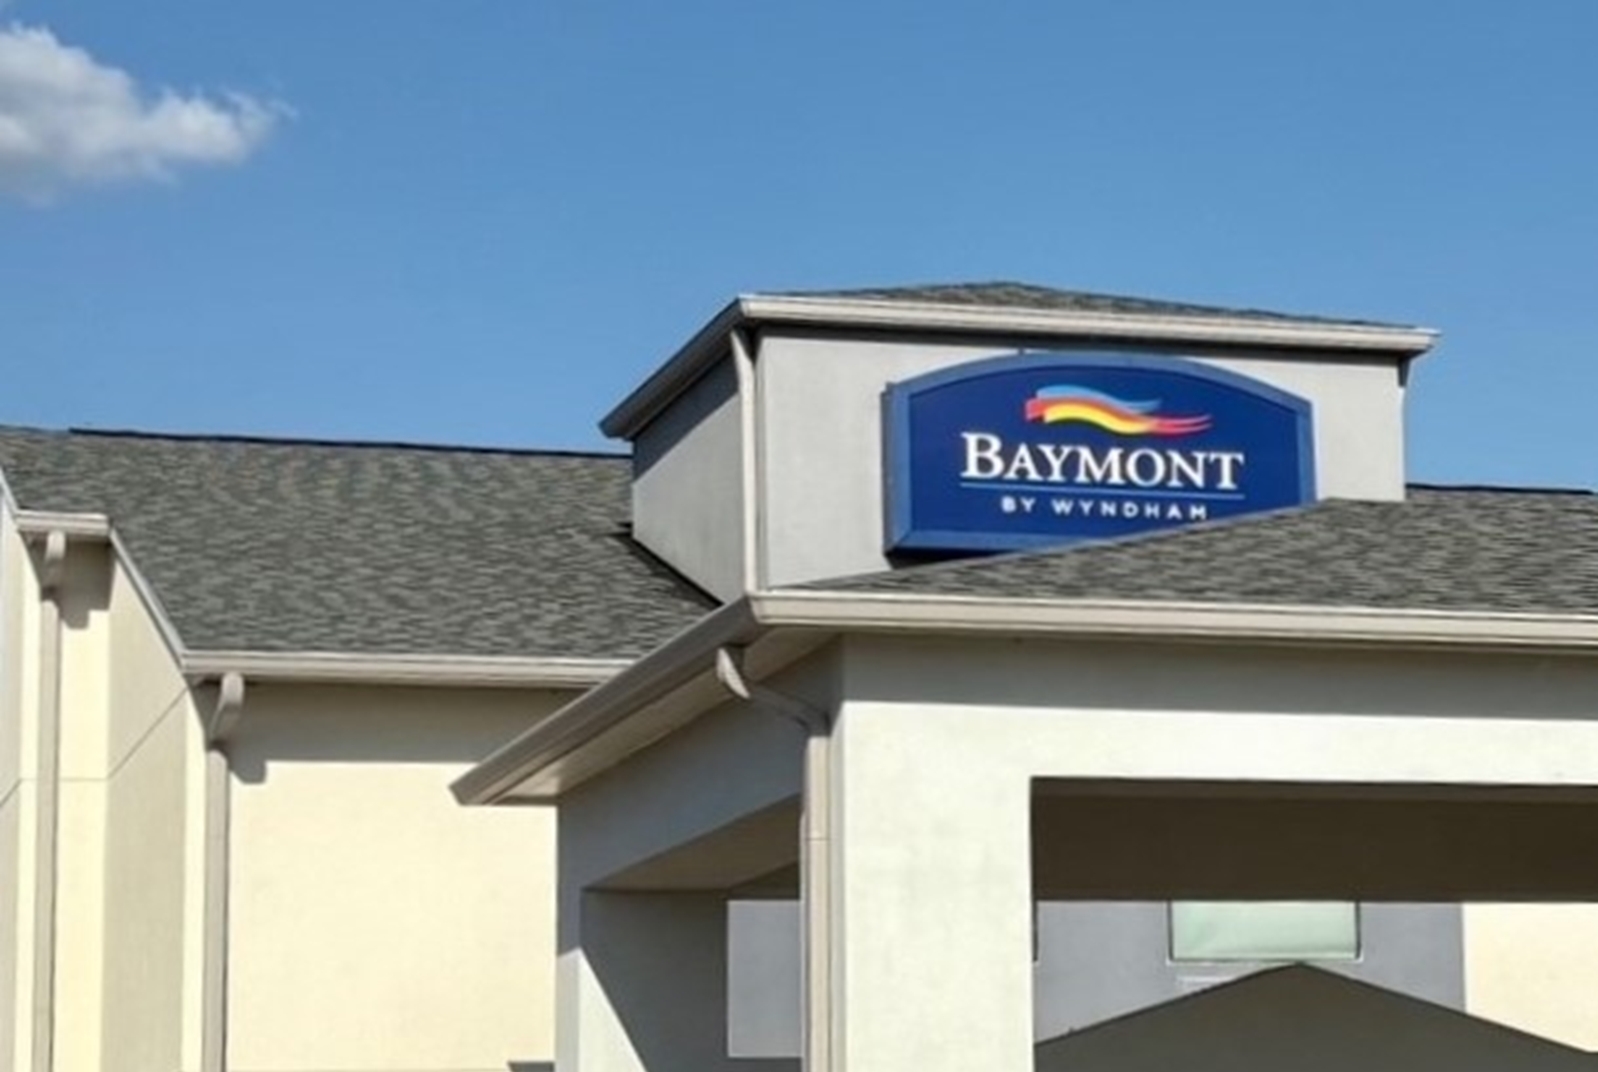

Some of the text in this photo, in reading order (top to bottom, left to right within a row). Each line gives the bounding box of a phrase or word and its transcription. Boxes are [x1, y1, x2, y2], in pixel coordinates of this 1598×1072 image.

[960, 432, 1244, 489] BAYMONT
[1001, 496, 1208, 520] BY WYNDHAM
